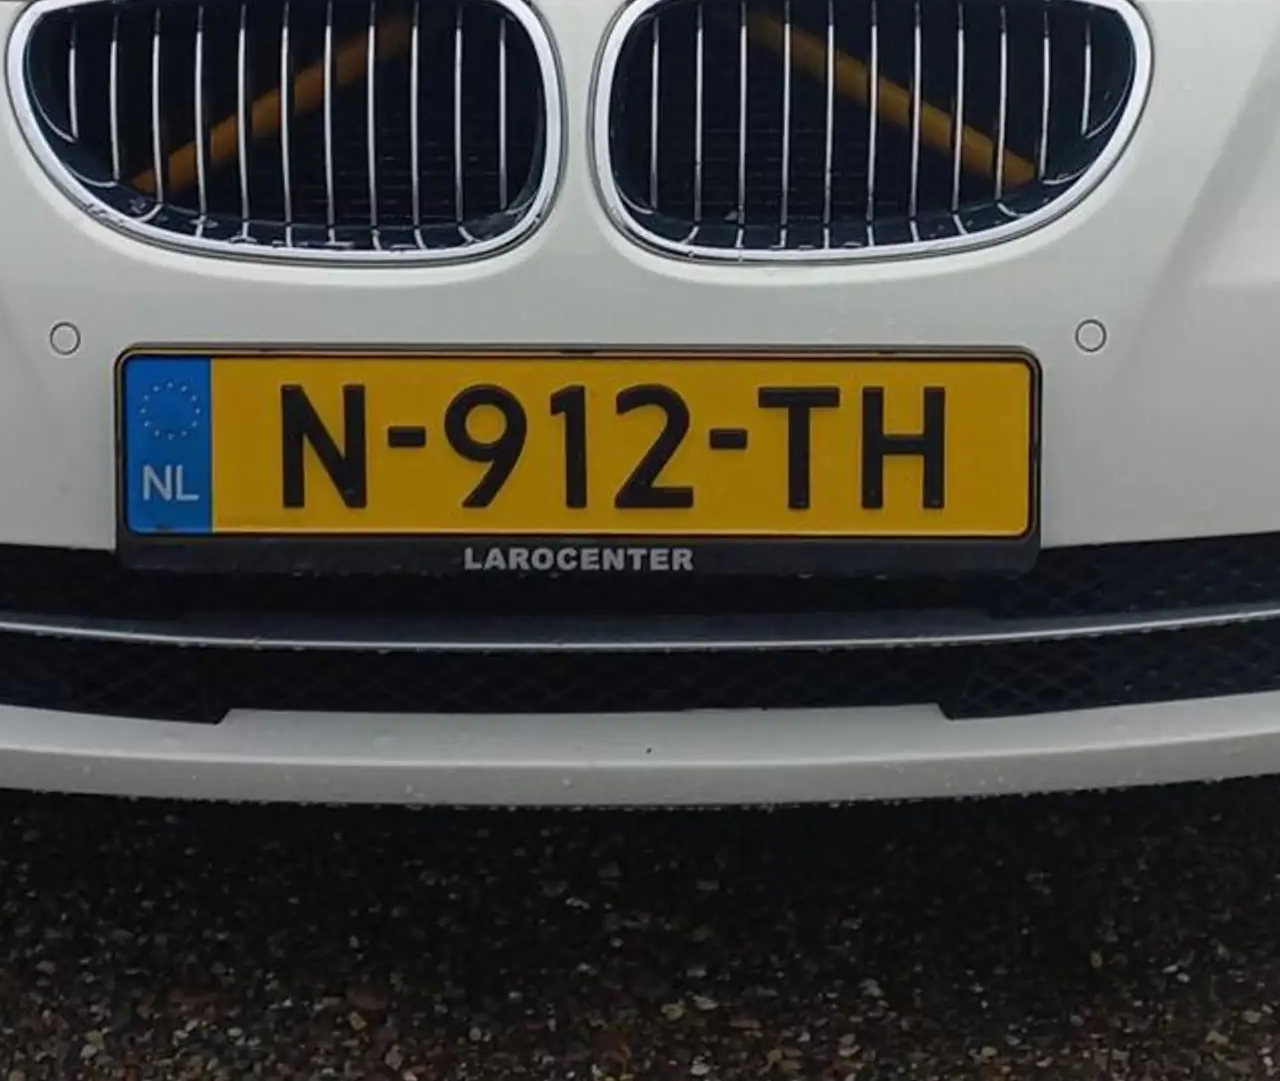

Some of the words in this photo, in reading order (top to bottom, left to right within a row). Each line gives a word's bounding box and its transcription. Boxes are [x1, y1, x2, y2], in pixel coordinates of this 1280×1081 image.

[281, 385, 946, 510] N-912-TH
[143, 464, 200, 501] NL
[464, 547, 694, 572] LAROCENTER
